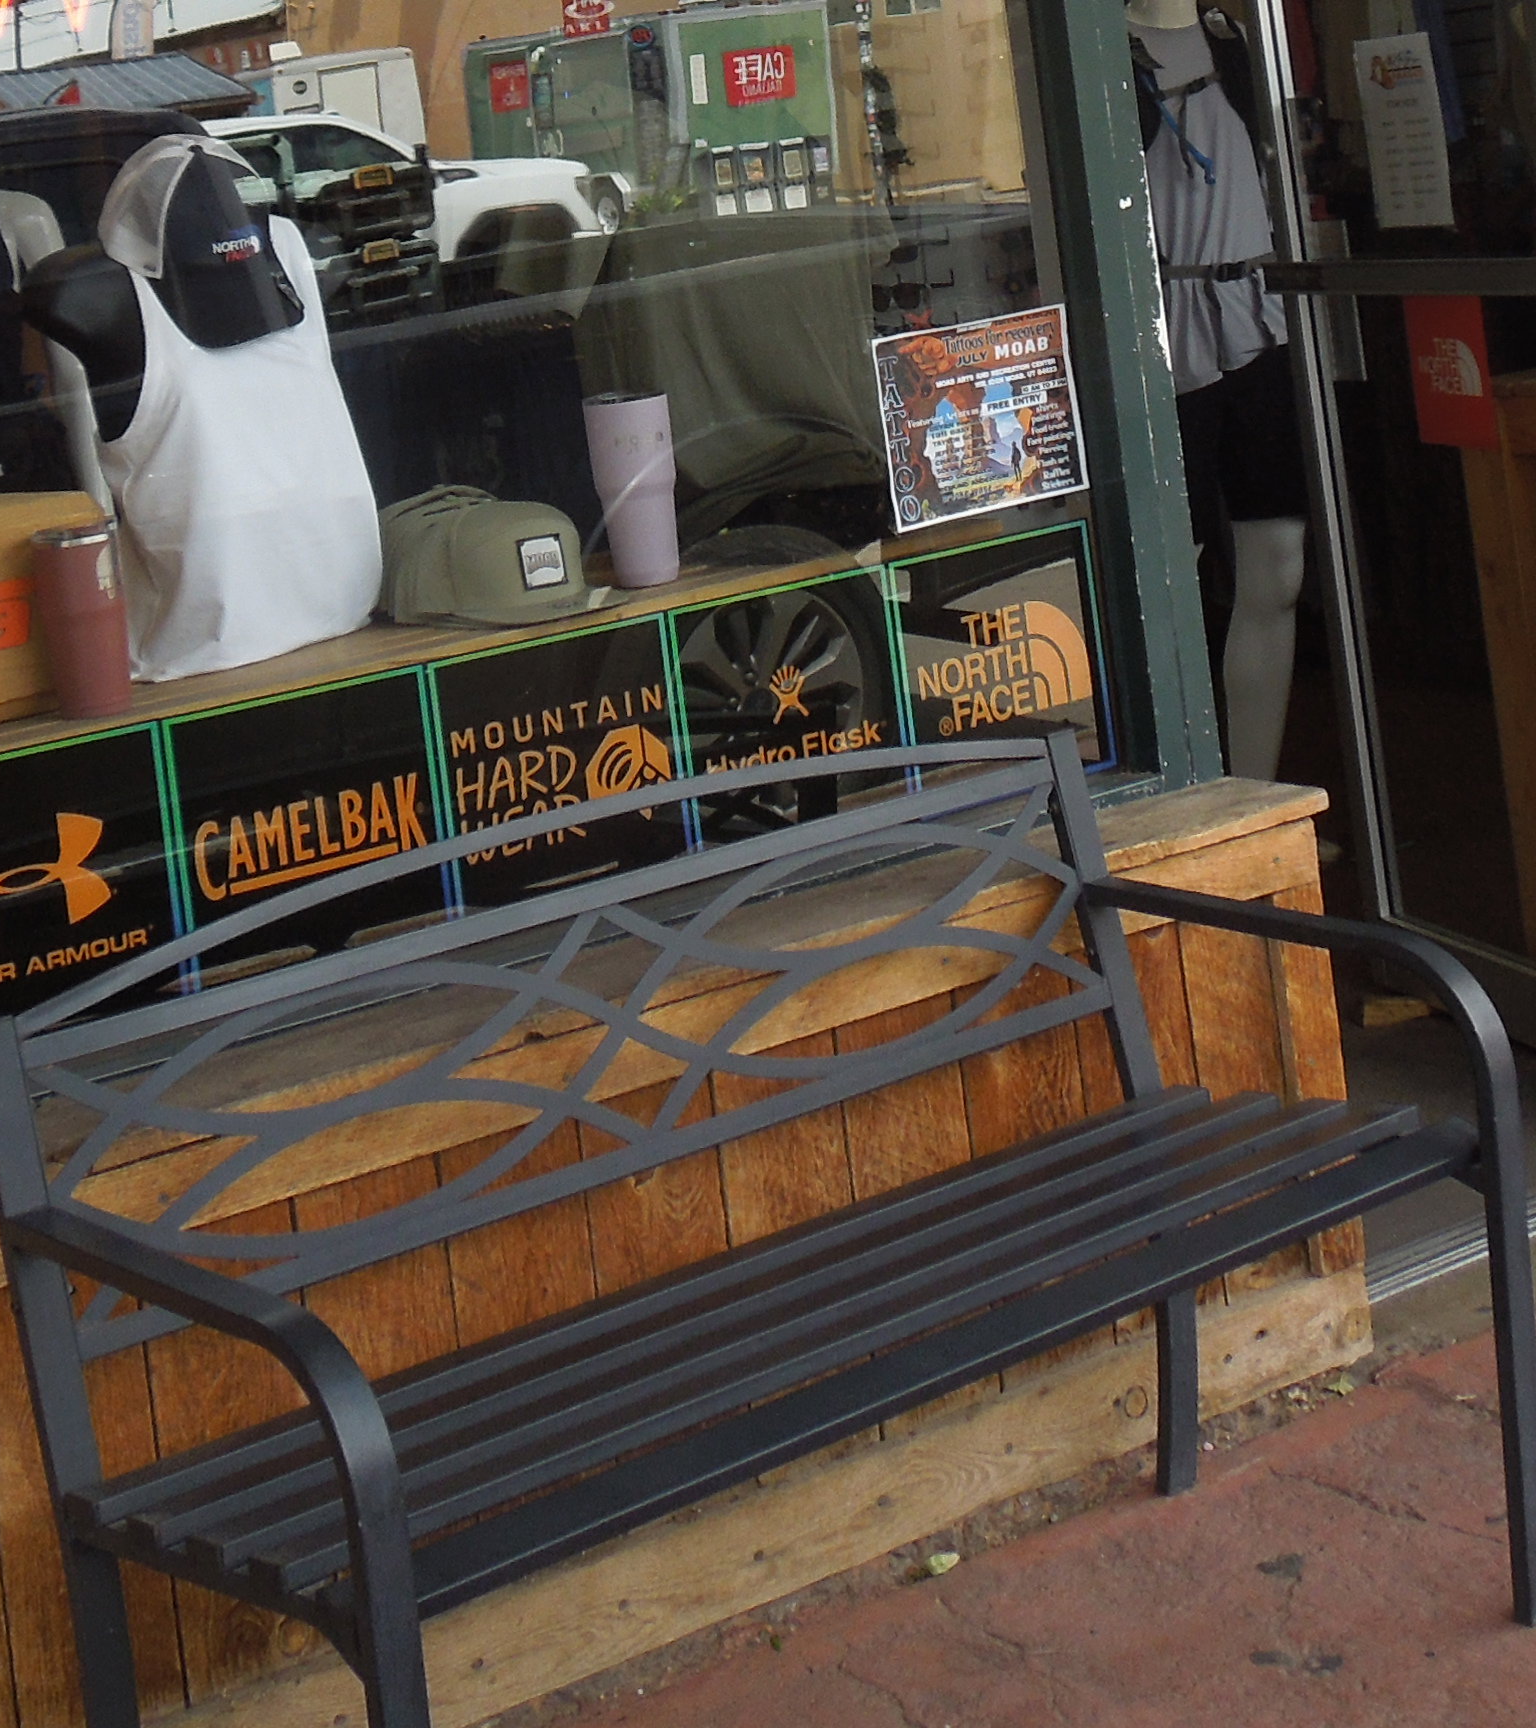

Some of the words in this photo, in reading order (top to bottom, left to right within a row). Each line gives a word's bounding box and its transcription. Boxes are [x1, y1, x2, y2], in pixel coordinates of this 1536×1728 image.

[211, 238, 252, 255] NORTH
[942, 332, 984, 355] Tattoos
[986, 328, 1003, 345] for
[956, 351, 988, 367] JULY
[994, 336, 1049, 361] MOAB
[986, 400, 1011, 412] FREE
[1013, 393, 1042, 408] ENTRY
[960, 603, 1023, 649] THE
[917, 641, 1029, 701] NORTH
[449, 683, 664, 758] MOUNTAIN
[952, 678, 1034, 732] FACE
[801, 720, 883, 759] Flask
[455, 744, 577, 815] HARD
[194, 772, 428, 902] CAMELBAK
[24, 928, 150, 976] ARMOUR
